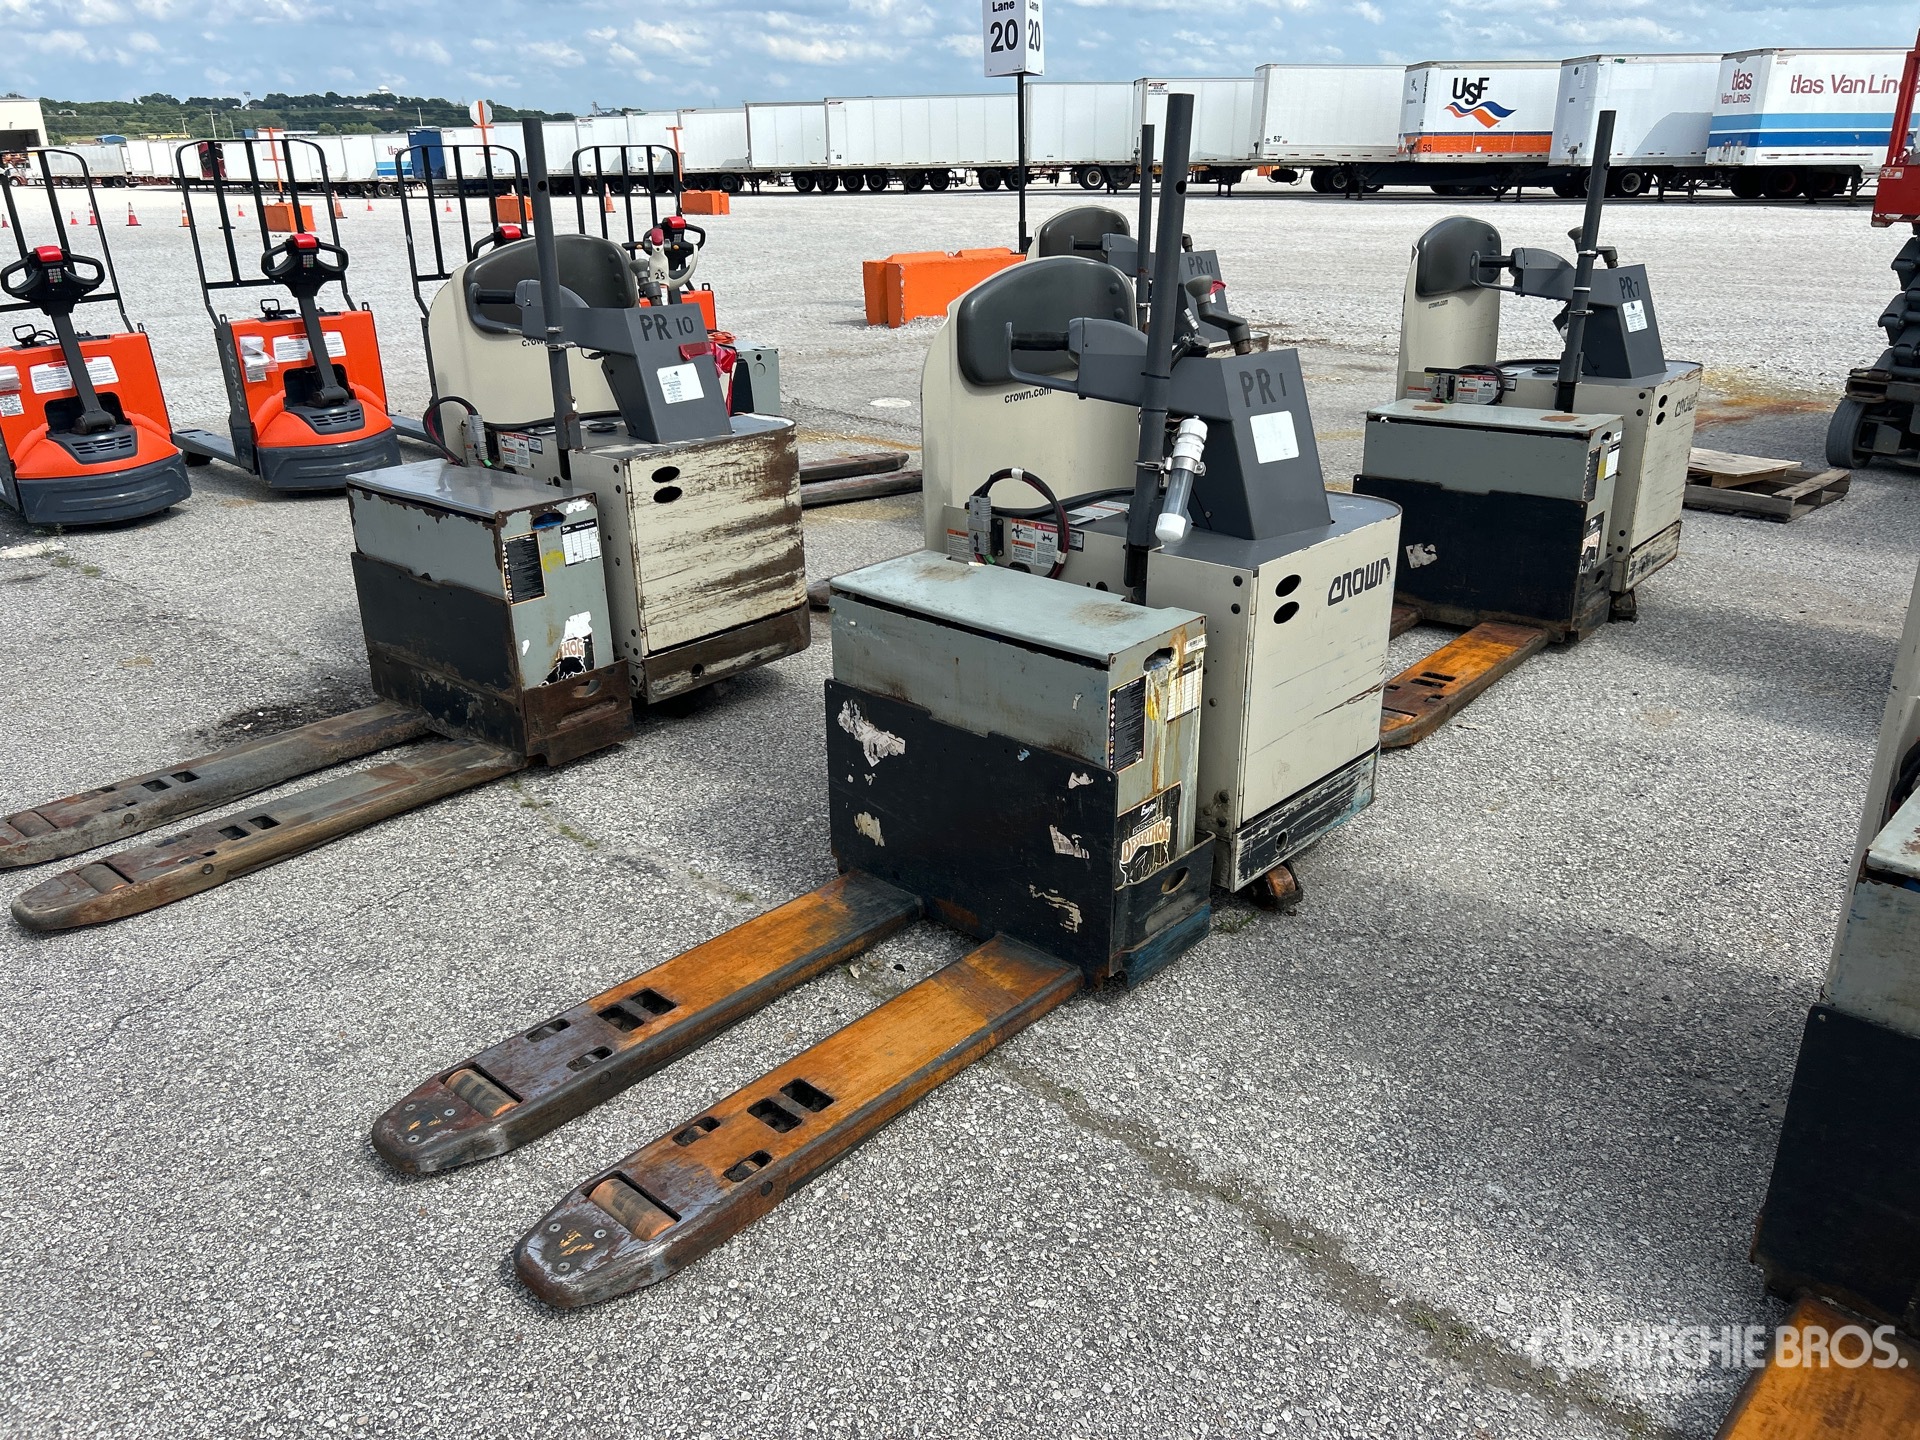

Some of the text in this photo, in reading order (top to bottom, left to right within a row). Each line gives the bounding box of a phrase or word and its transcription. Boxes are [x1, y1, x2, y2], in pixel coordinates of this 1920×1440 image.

[992, 0, 1015, 13] Lane
[990, 18, 1019, 53] 20
[1028, 18, 1041, 52] 20
[1452, 77, 1490, 105] USF
[1721, 92, 1751, 104] Van Lines
[1790, 74, 1824, 95] tlas
[1831, 74, 1866, 94] Van
[1422, 144, 1432, 153] 53
[654, 271, 666, 280] 25
[639, 313, 695, 342] PR 10
[226, 343, 244, 413] TOYOTA
[1239, 368, 1277, 408] PR
[1004, 386, 1052, 404] crown.com
[1327, 557, 1391, 607] CROWN
